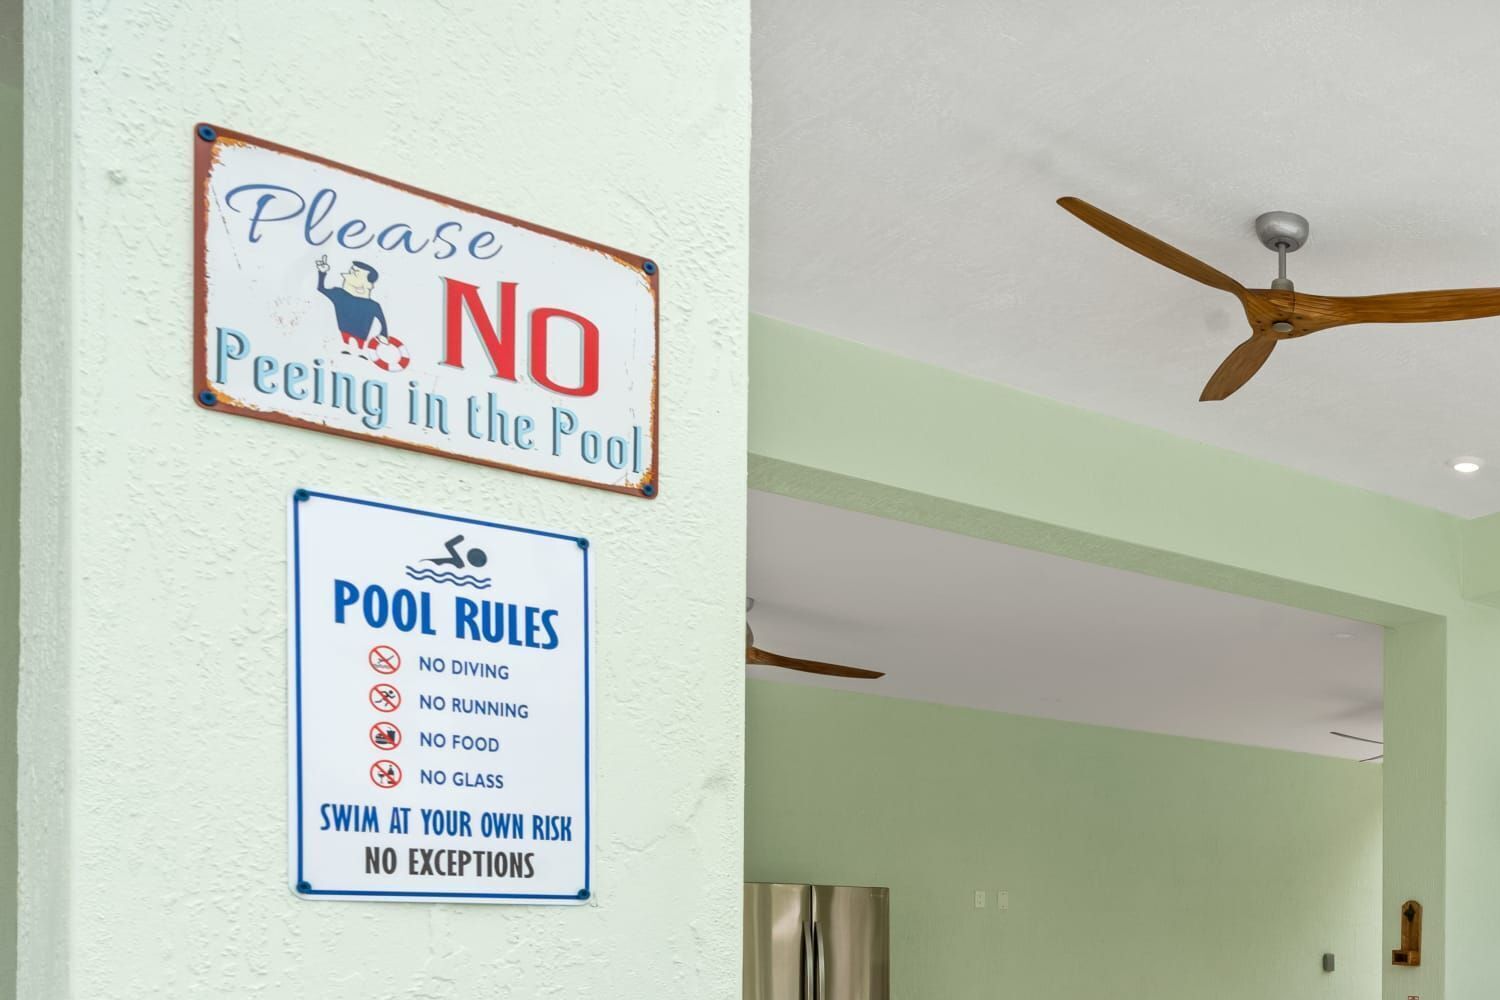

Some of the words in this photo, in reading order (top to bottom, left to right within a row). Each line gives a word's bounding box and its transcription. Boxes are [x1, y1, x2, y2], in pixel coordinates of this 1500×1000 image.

[225, 183, 504, 260] Please
[215, 326, 387, 430] Peeing
[408, 380, 450, 435] in
[468, 392, 536, 450] the
[551, 406, 643, 473] Pool
[334, 578, 437, 636] POOL
[455, 596, 559, 650] RULES
[419, 655, 446, 674] NO
[451, 660, 509, 680] DIVING
[419, 694, 446, 712] NO
[451, 699, 529, 719] RUNNING
[419, 732, 446, 749] NO
[452, 735, 500, 752] FOOD
[420, 769, 447, 786] NO
[452, 772, 504, 790] GLASS
[320, 803, 380, 833] SWIM
[389, 807, 411, 835] AT
[420, 809, 473, 837] YOUR
[480, 812, 524, 840] OWN
[532, 815, 572, 842] RISK
[365, 846, 397, 875] NO
[408, 848, 535, 879] EXCEPTIONS
